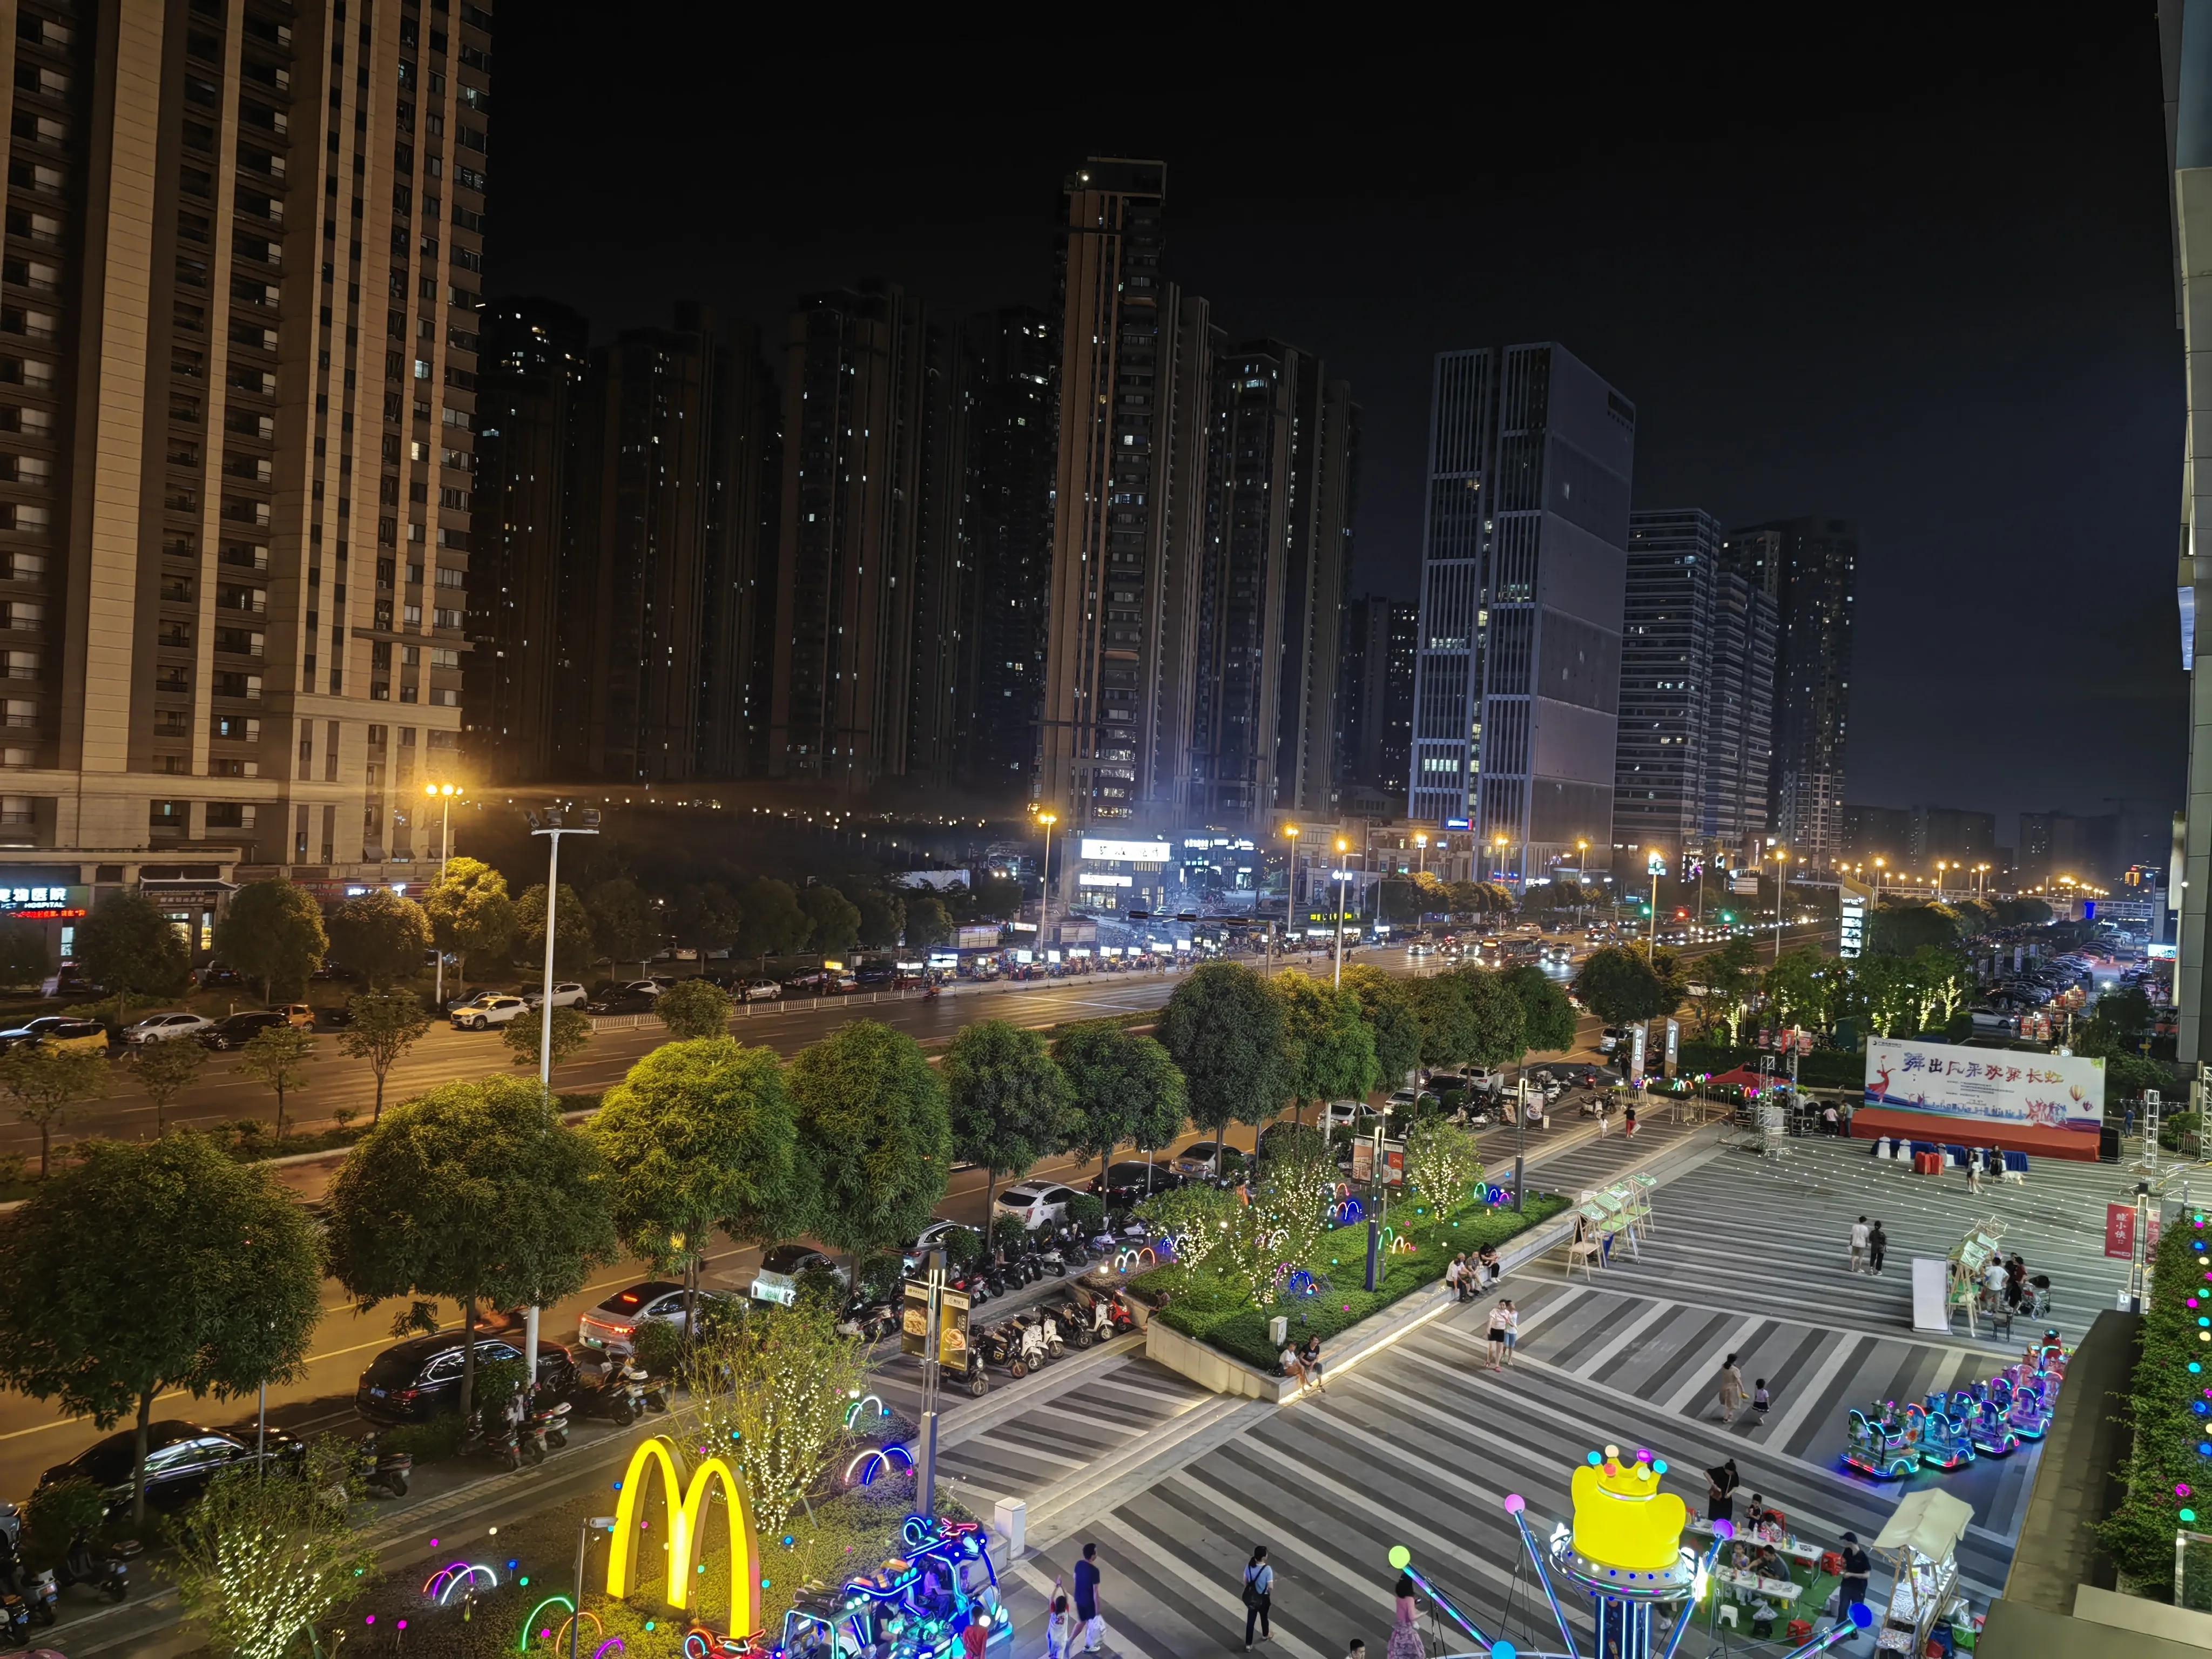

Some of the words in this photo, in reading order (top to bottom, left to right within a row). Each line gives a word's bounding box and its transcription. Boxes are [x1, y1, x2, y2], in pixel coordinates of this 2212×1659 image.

[1901, 1052, 2064, 1084] 舞出风采欢聚长虹
